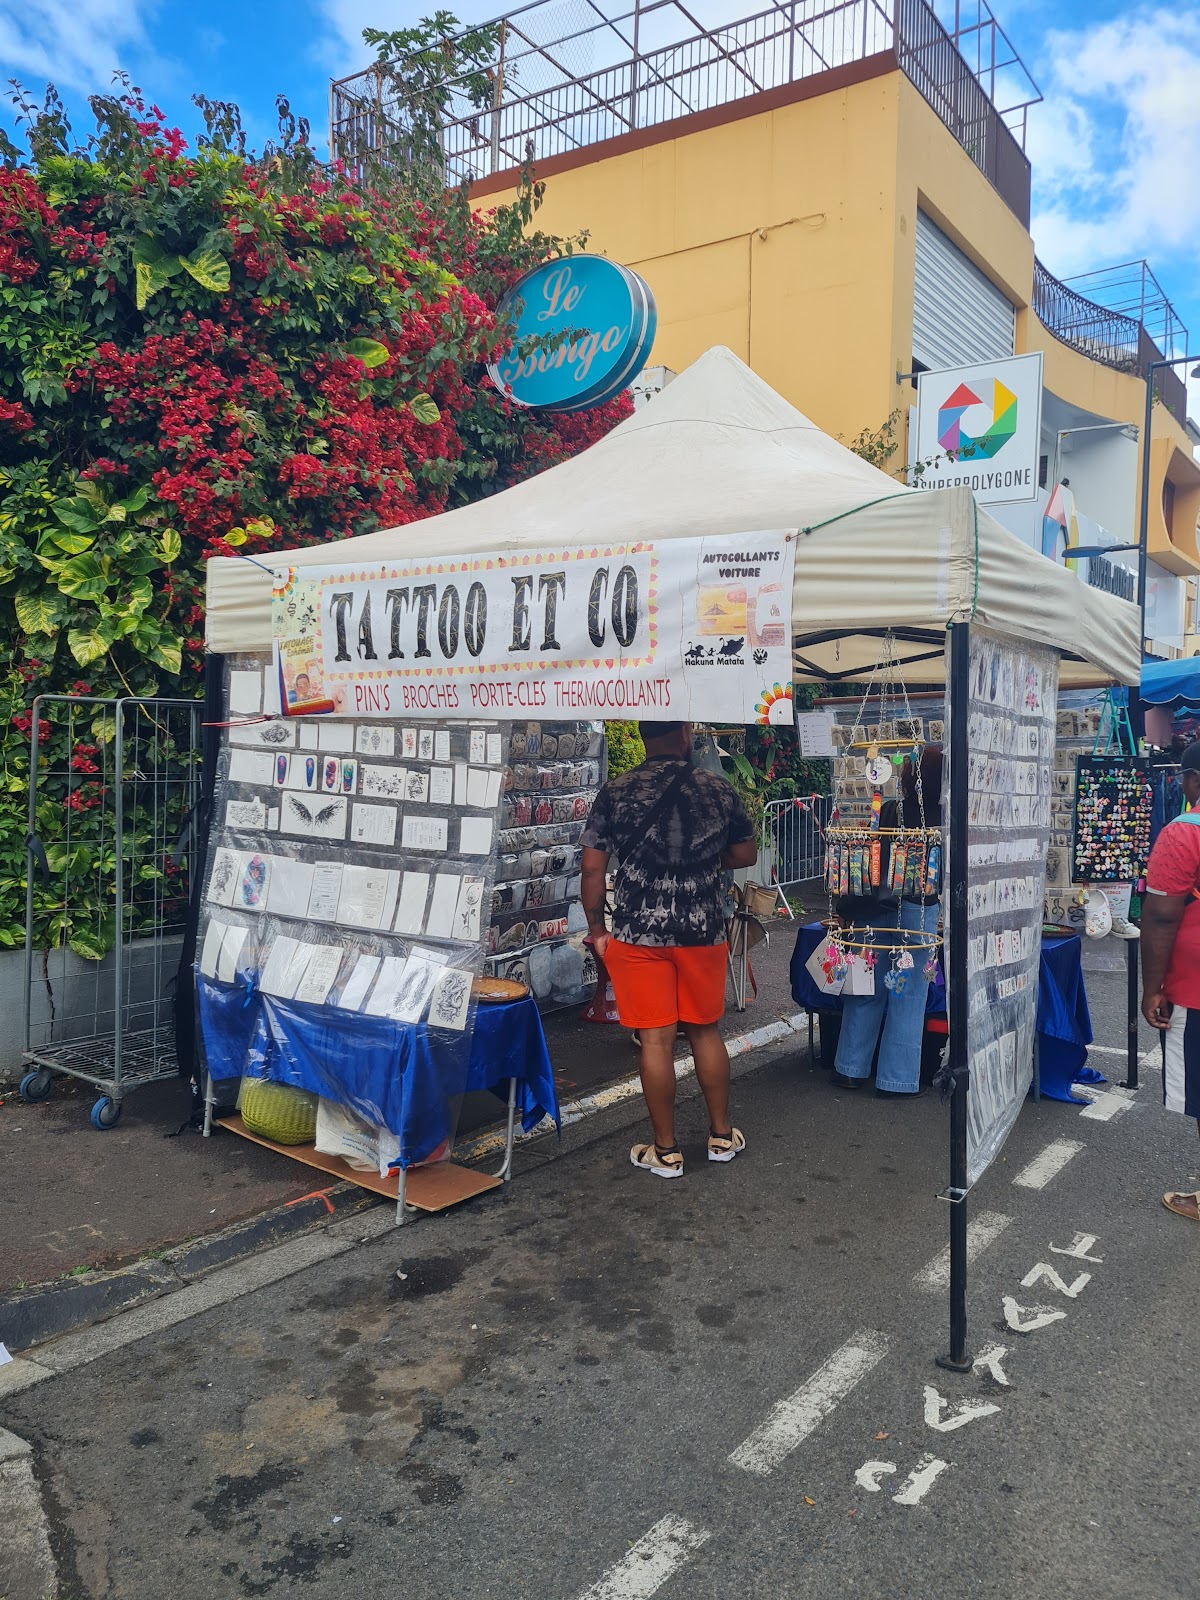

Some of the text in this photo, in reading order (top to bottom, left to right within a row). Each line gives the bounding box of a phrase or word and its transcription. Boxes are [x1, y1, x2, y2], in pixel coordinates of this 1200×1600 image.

[537, 266, 588, 322] Le
[703, 550, 780, 564] AUTOCOLLANTS
[719, 567, 762, 578] VOITURE
[330, 565, 639, 662] TATTOO ET CO
[684, 657, 746, 666] Hakuna Matata
[354, 679, 671, 712] PIN'S BROCHES PORTE-CLES THERMOCOLLANTS
